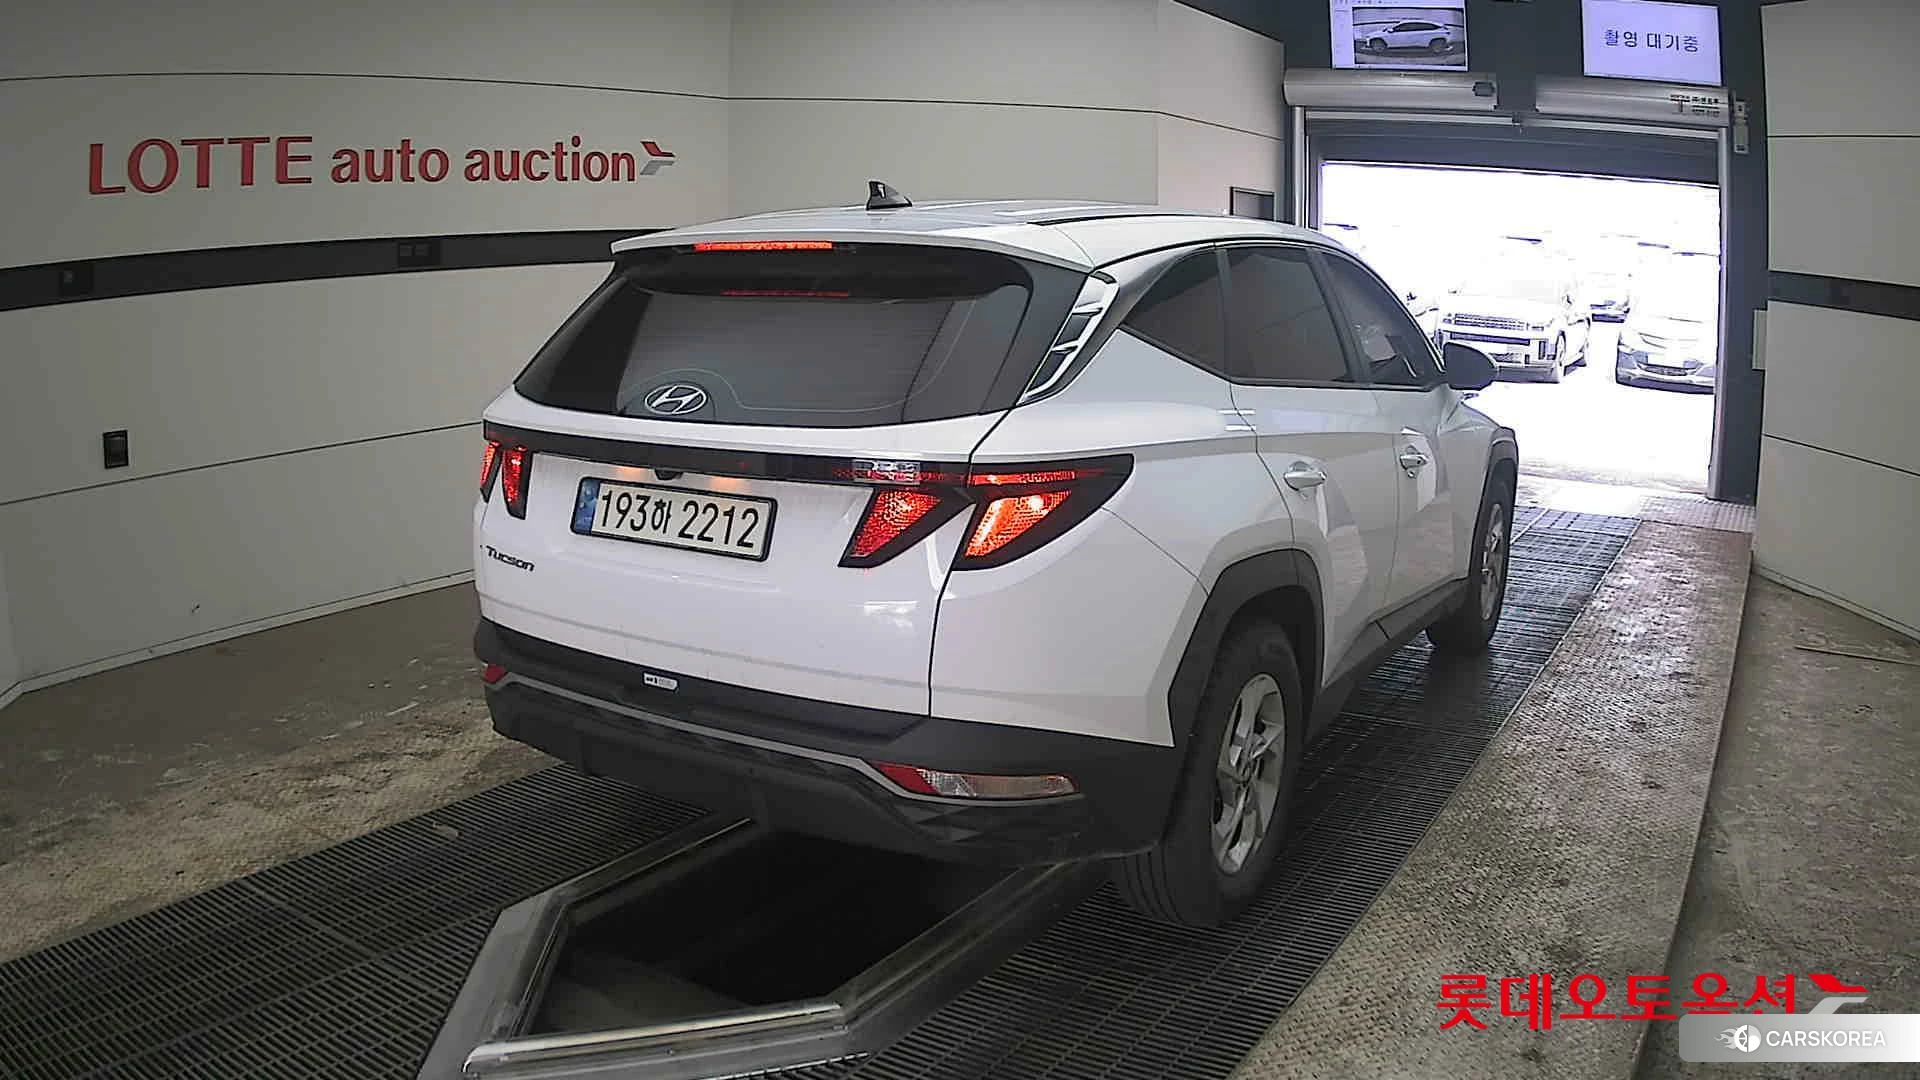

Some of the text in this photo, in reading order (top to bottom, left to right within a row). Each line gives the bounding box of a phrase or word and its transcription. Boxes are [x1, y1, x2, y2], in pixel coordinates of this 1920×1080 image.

[1645, 32, 1699, 53] 대기중
[88, 135, 637, 195] LOTTE auto auction
[601, 489, 760, 549] 193하 2212
